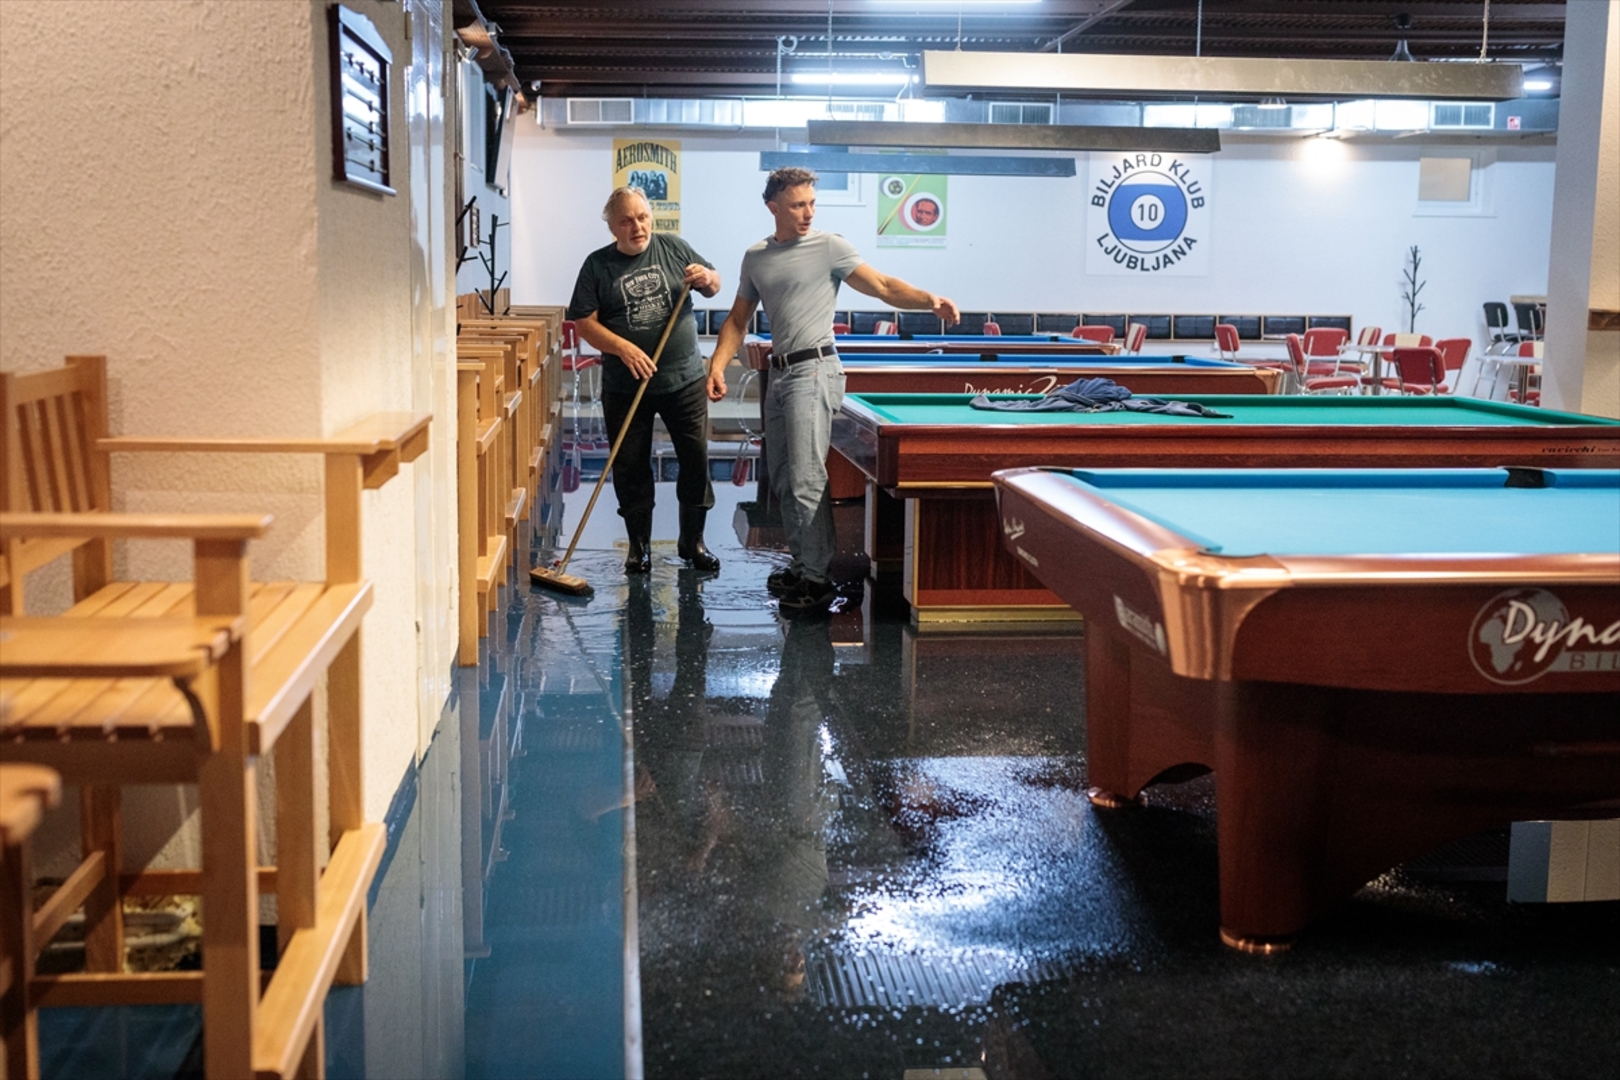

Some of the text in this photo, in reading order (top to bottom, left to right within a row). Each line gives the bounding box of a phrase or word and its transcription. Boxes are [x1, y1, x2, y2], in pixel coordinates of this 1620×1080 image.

[615, 142, 677, 174] AEROSMITH
[1091, 153, 1205, 209] BILJARD KLUB
[1138, 203, 1158, 221] 10
[1096, 233, 1198, 272] LJUBLJANA
